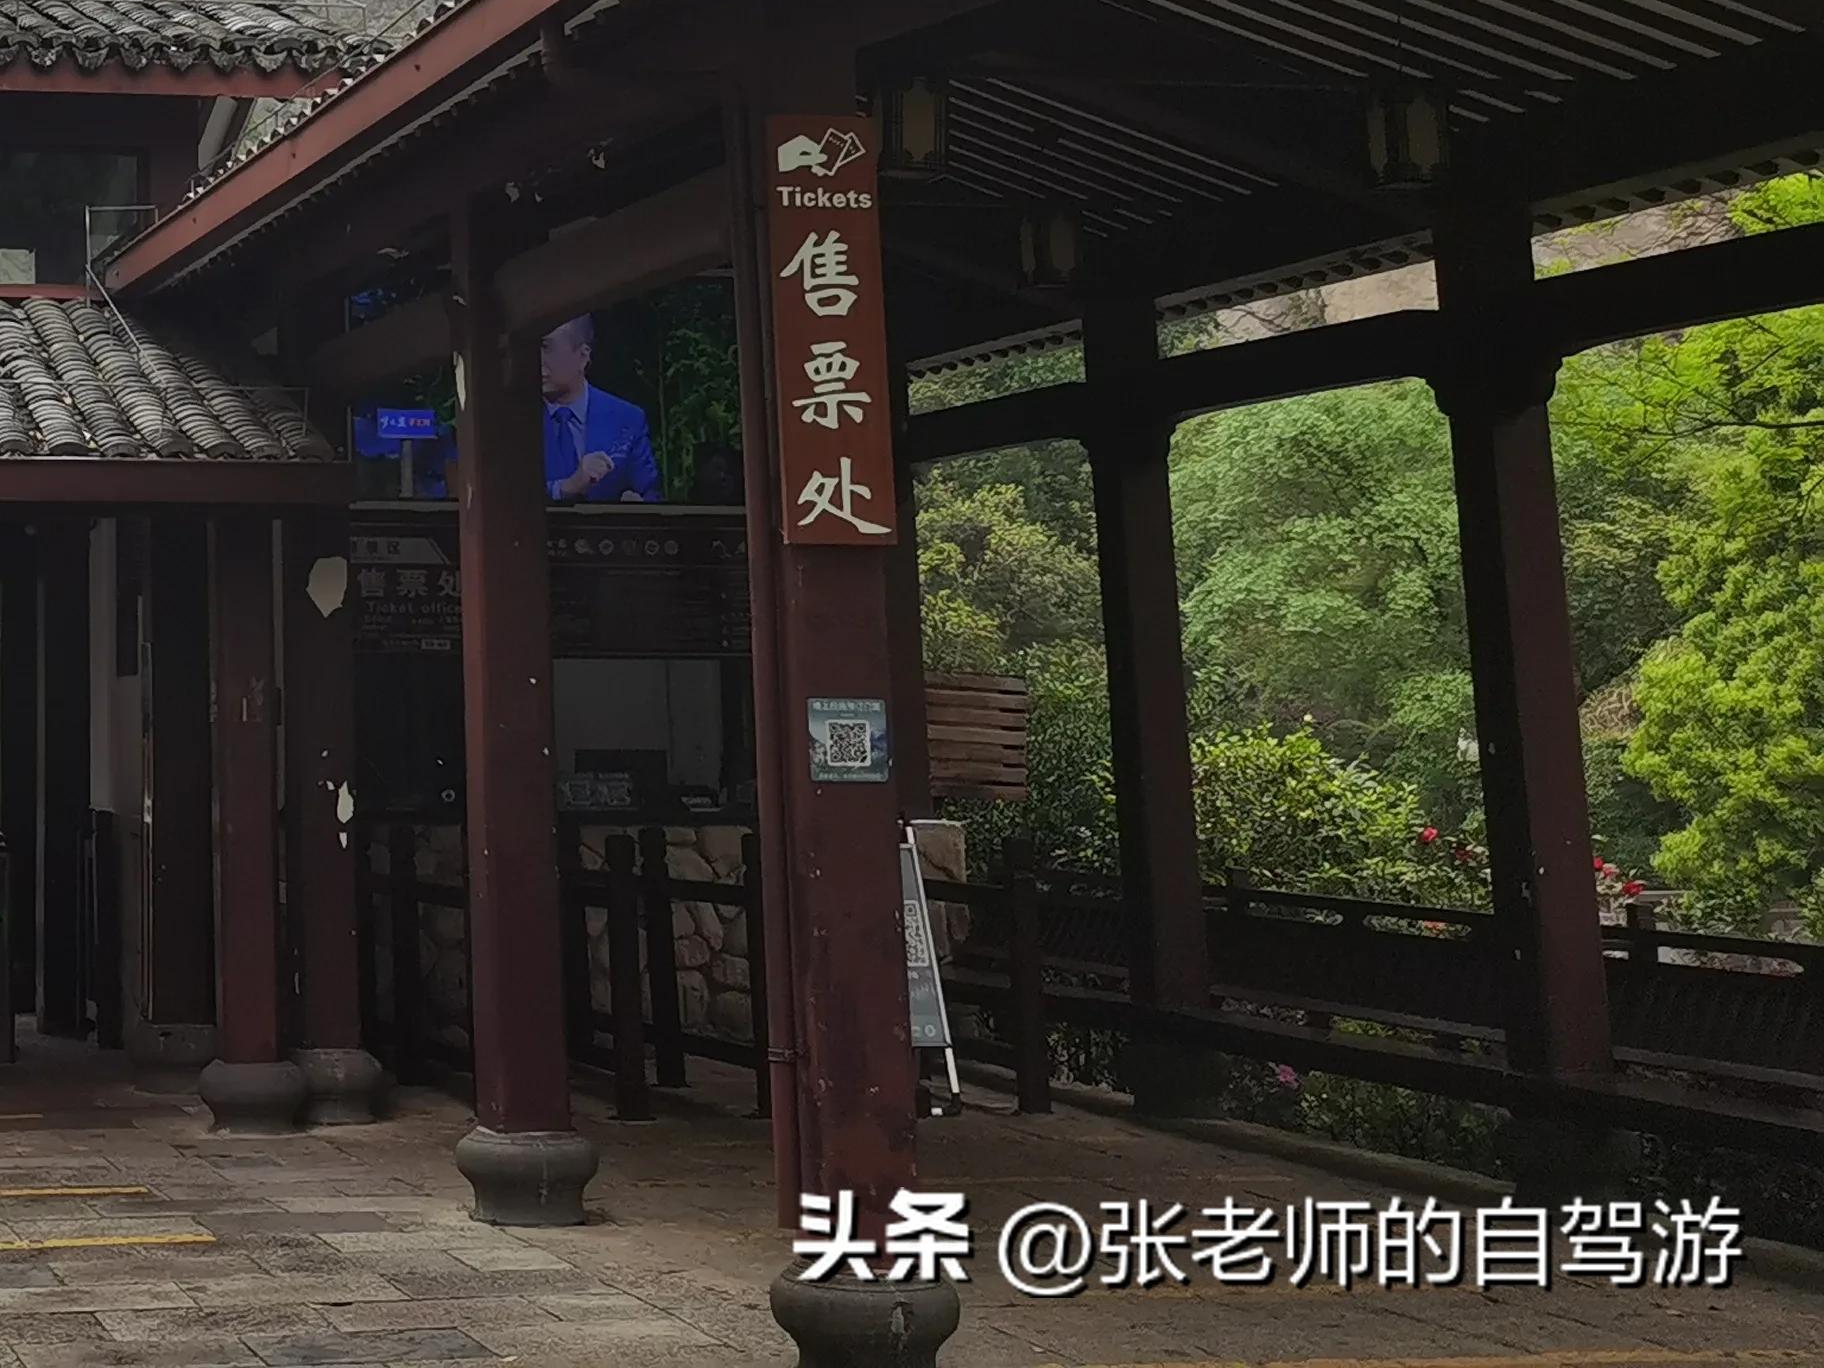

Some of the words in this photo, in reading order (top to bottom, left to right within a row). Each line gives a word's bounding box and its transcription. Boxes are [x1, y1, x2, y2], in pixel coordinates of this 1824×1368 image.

[776, 186, 873, 209] Tickets
[780, 229, 893, 535] 售票处
